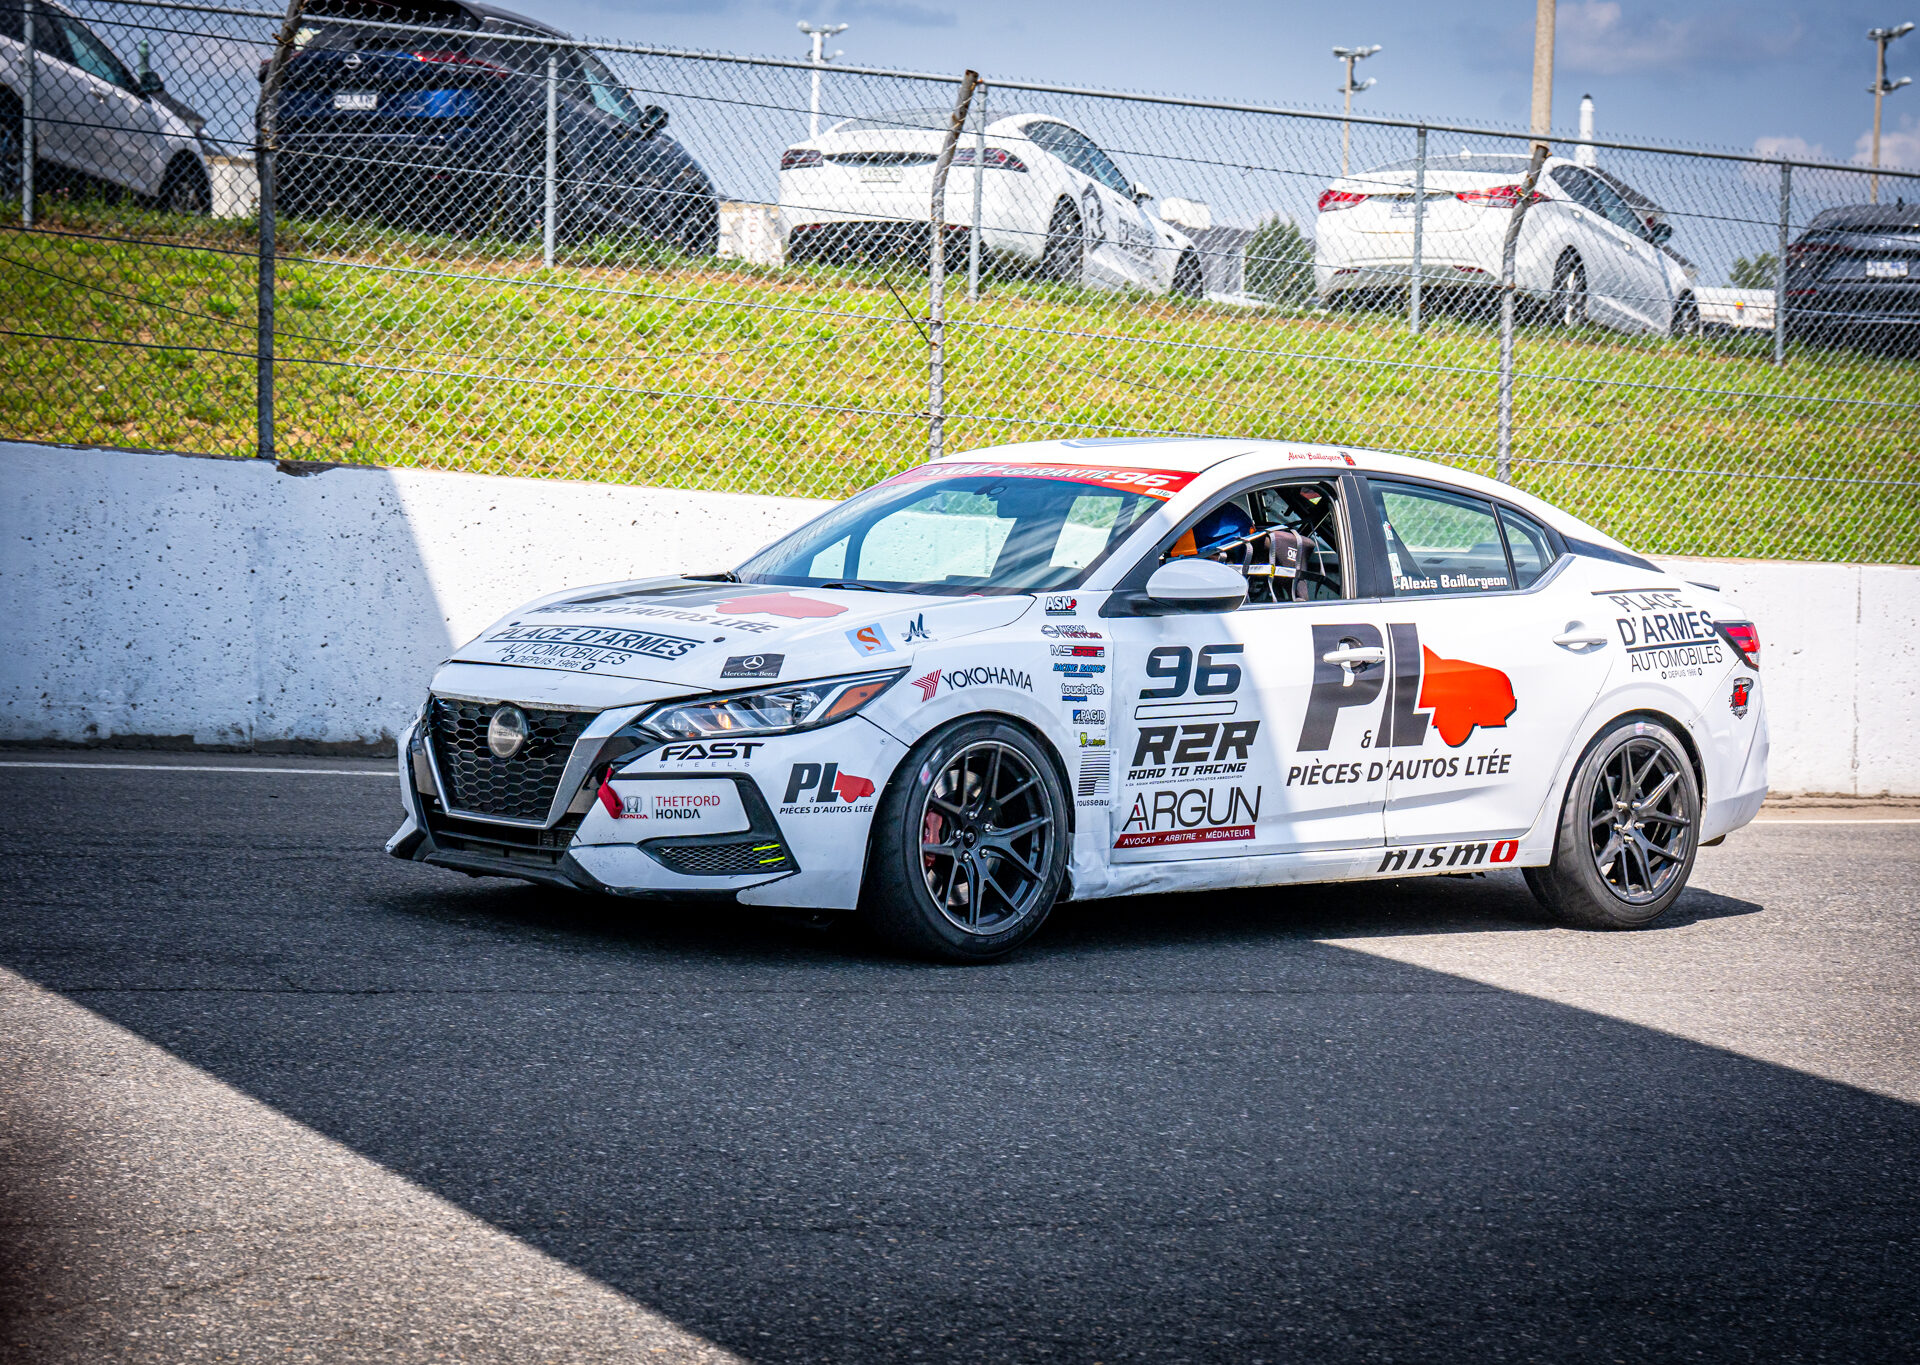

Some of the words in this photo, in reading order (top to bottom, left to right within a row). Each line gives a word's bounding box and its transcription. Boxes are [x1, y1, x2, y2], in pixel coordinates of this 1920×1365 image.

[1101, 472, 1182, 487] 96
[1400, 576, 1438, 590] Alexis
[1440, 573, 1508, 590] Baillargeon
[1045, 596, 1072, 610] ASN
[1608, 593, 1693, 613] PLACE
[710, 614, 779, 634] LTÉE
[1616, 610, 1717, 646] D'ARMES
[490, 627, 573, 640] PLACE
[572, 629, 697, 657] D'ARMES
[496, 642, 632, 665] AUTOMOBILES
[513, 655, 556, 667] DEPUIS
[1631, 645, 1723, 673] AUTOMOBILES
[722, 670, 777, 678] Mercedes-Benz
[1053, 663, 1078, 672] RACING
[1139, 644, 1244, 699] 96
[941, 666, 1034, 692] YOKOHAMA
[1061, 683, 1104, 695] touchette
[1080, 709, 1106, 721] PAGID
[659, 743, 765, 761] FAST
[1132, 720, 1260, 767] R2R
[1127, 768, 1166, 780] ROAD
[1171, 766, 1190, 776] TO
[1193, 762, 1247, 775] RACING
[1286, 759, 1362, 786] PIÈCES
[1367, 757, 1459, 782] D'AUTOS
[1465, 749, 1512, 776] LTÉE
[656, 795, 720, 807] THETFORD
[780, 804, 810, 815] PIÈCES
[813, 805, 852, 814] D'AUTOS
[855, 804, 873, 812] LTÉE
[1077, 798, 1109, 807] rousseau
[1122, 786, 1261, 832] ARGUN
[655, 809, 701, 819] HONDA
[1123, 836, 1156, 845] AVOCAT
[1164, 832, 1197, 842] ARBITRE
[1205, 828, 1250, 839] MÉDIATEUR
